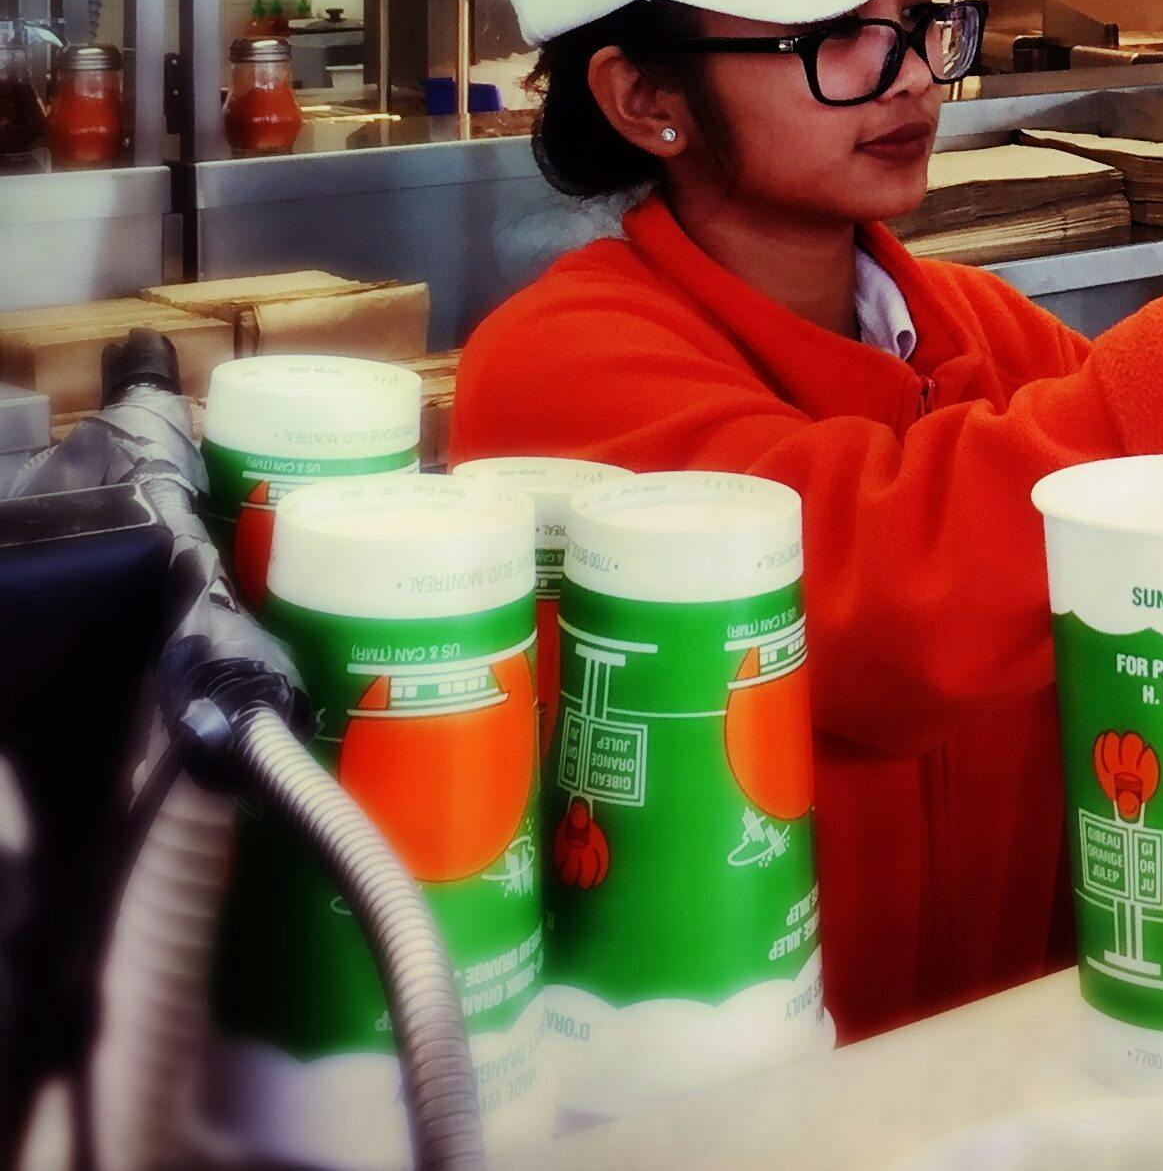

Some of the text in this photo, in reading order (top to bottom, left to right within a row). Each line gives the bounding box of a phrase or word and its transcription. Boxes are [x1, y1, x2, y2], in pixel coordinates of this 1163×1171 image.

[407, 563, 492, 594] MONTREAL
[726, 613, 780, 639] (TMR) CAN
[351, 643, 392, 663] (TMR)
[394, 643, 425, 662] CAN
[442, 642, 461, 658] US
[1116, 653, 1149, 677] FOR
[1142, 685, 1160, 706] H.
[596, 735, 631, 754] JULEP
[590, 752, 636, 773] ORANGE
[590, 770, 632, 791] GIBEAU
[1086, 825, 1122, 851] GIBEAU
[1085, 841, 1125, 868] ORANGE
[1090, 861, 1121, 883] JULEP
[768, 926, 803, 962] JULEP
